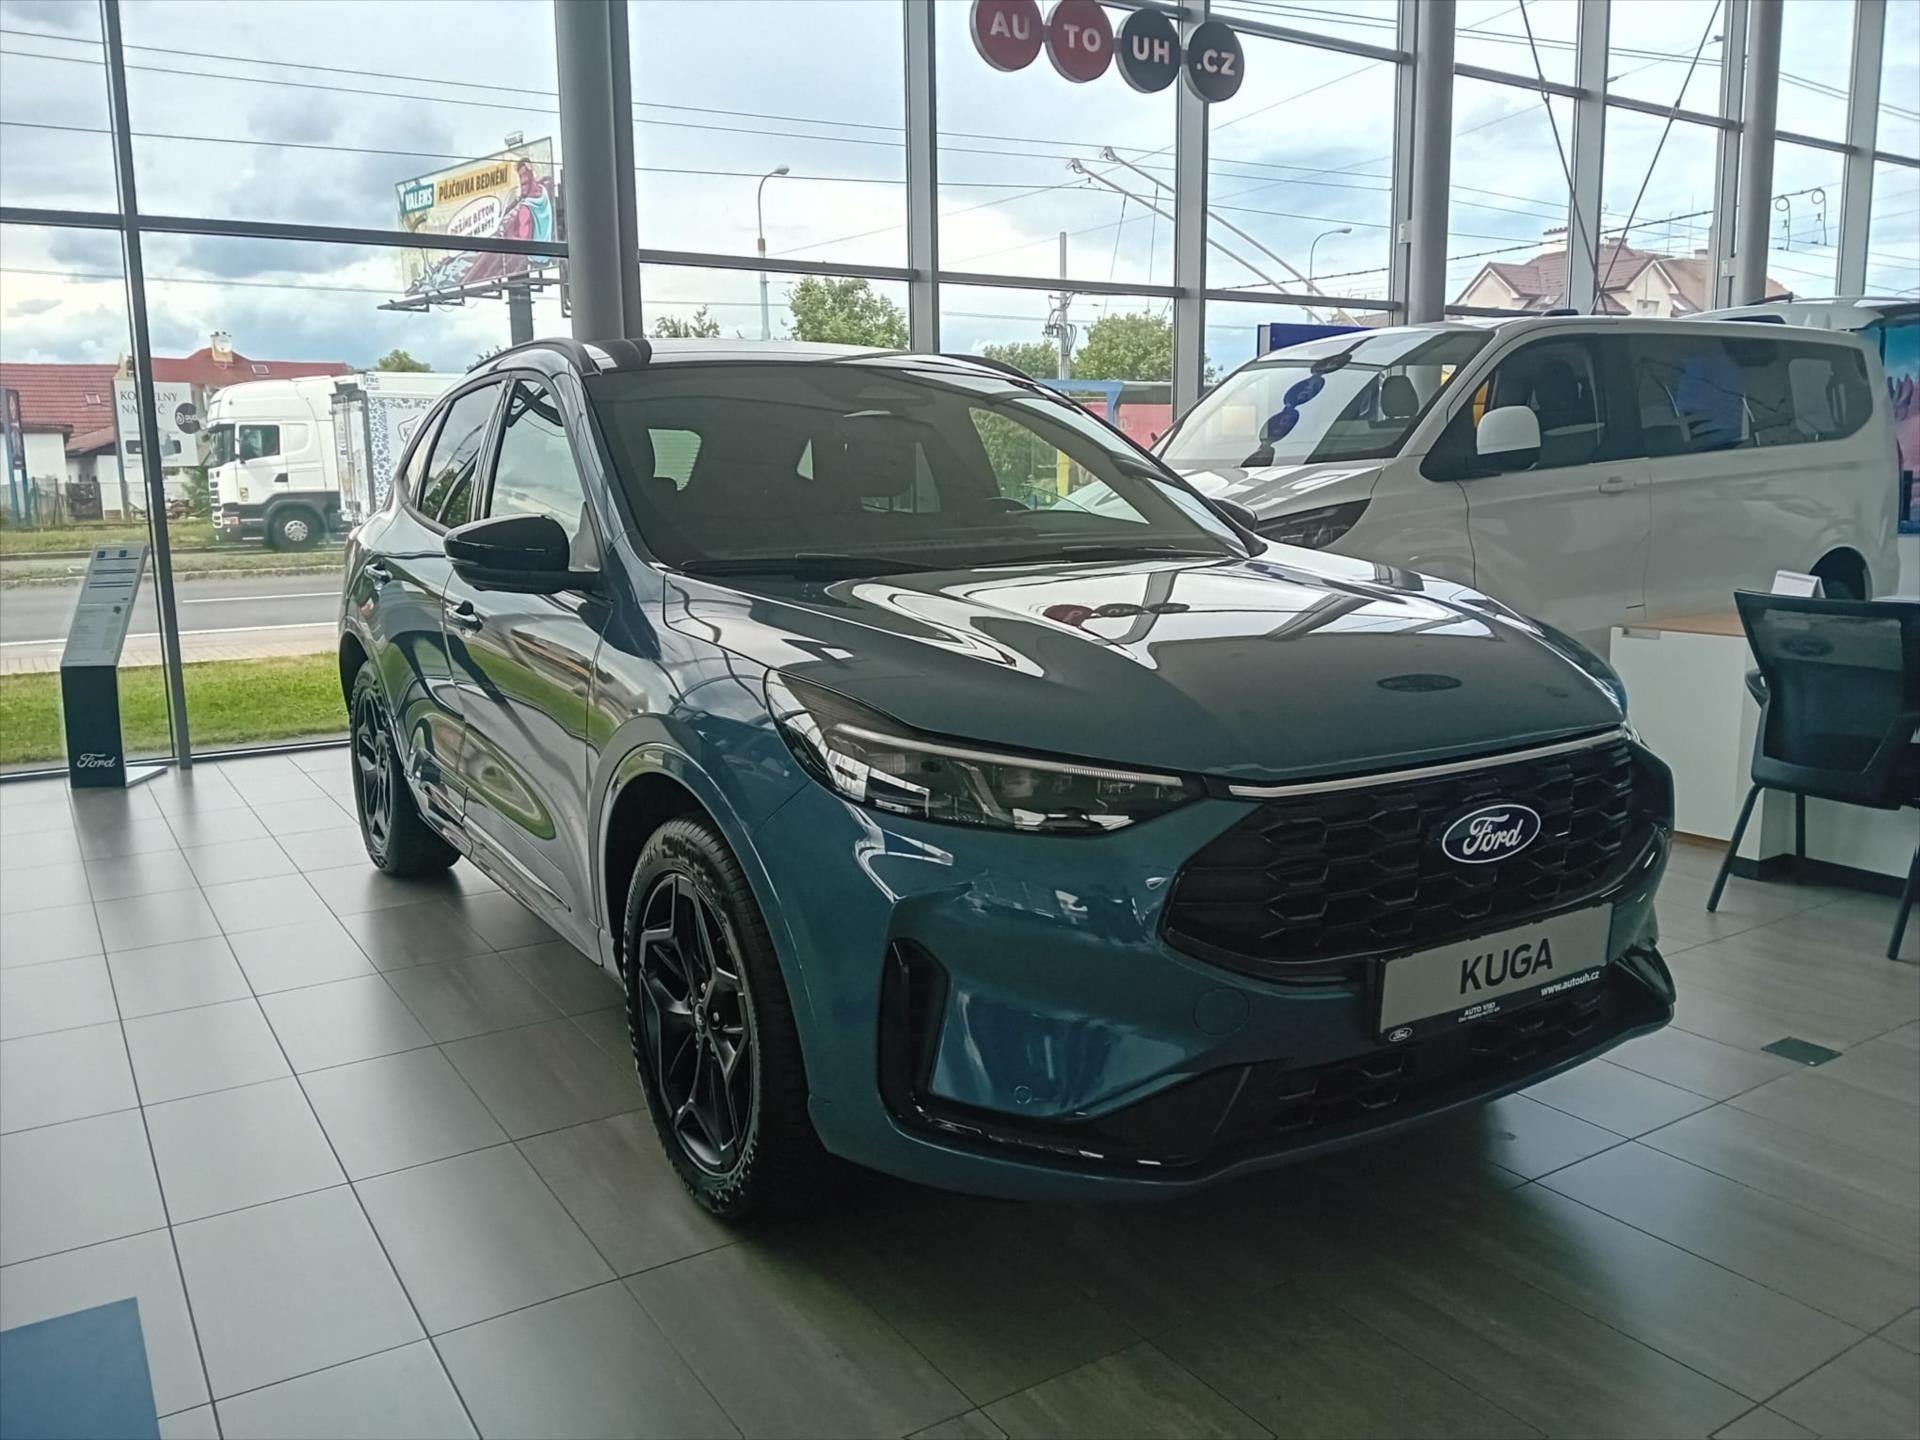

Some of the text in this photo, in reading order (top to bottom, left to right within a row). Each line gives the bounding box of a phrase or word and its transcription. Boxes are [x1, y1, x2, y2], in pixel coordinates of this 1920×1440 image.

[990, 11, 1236, 75] AU TO UH .CZ
[405, 187, 433, 211] VALENS
[438, 176, 475, 201] PŮJČOVNA
[473, 202, 495, 224] BETON
[76, 753, 116, 768] Ford
[1462, 813, 1524, 855] Ford
[1459, 938, 1553, 994] KUGA
[1540, 970, 1600, 996] www.autouh.cz
[1463, 1005, 1482, 1017] AUTO
